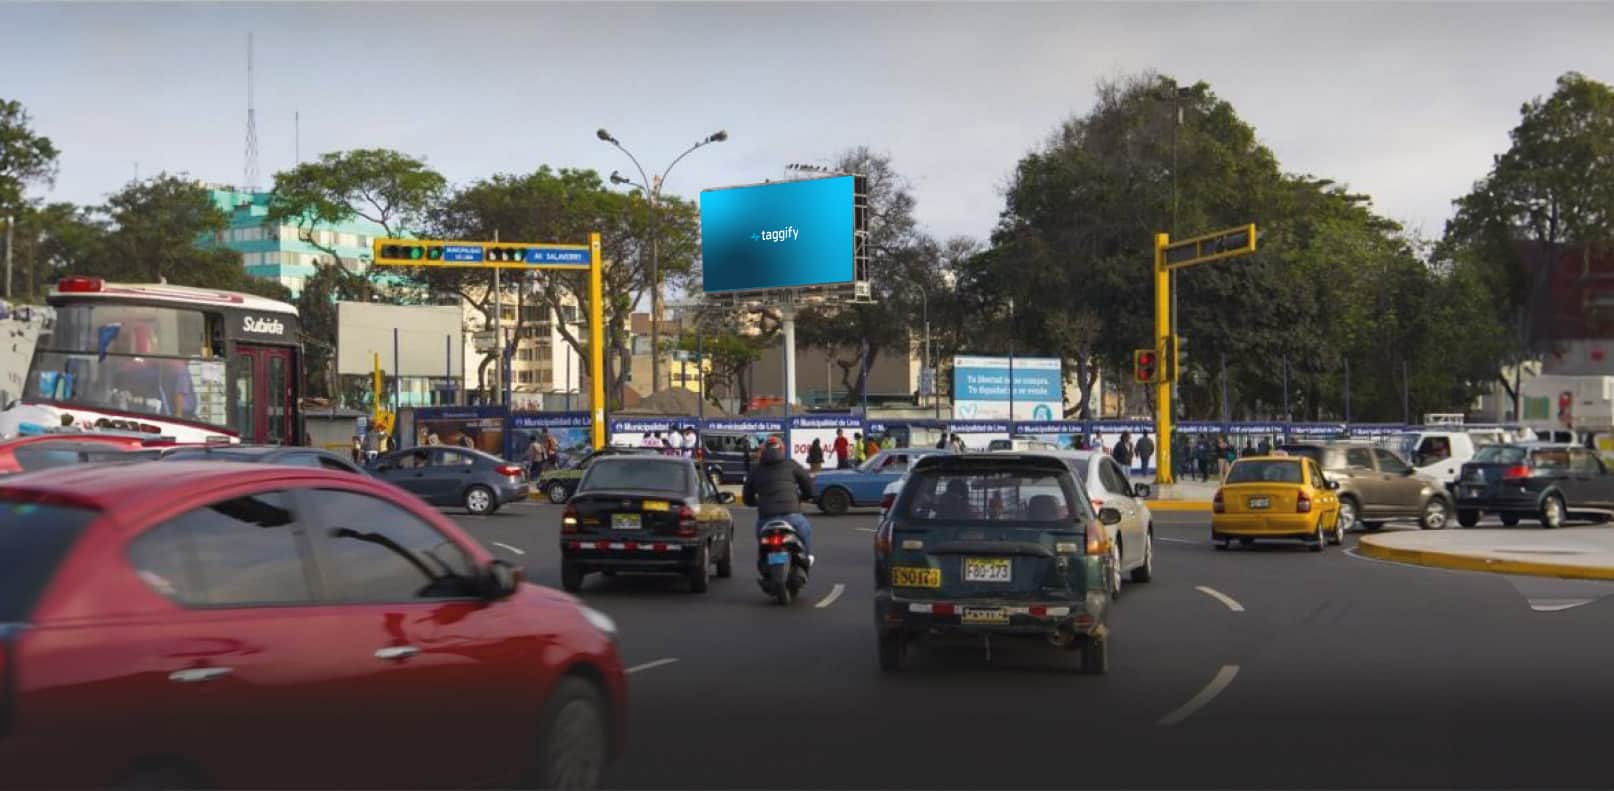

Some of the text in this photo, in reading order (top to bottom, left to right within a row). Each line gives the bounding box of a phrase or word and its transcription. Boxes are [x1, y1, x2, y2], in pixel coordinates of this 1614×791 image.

[761, 226, 799, 243] taggify
[243, 316, 284, 335] Subida
[624, 423, 670, 432] Municipalidad
[717, 422, 781, 432] Municipalidad de Lima
[801, 418, 860, 428] Municipalidad de Lima
[1025, 425, 1062, 434] Municipalidad
